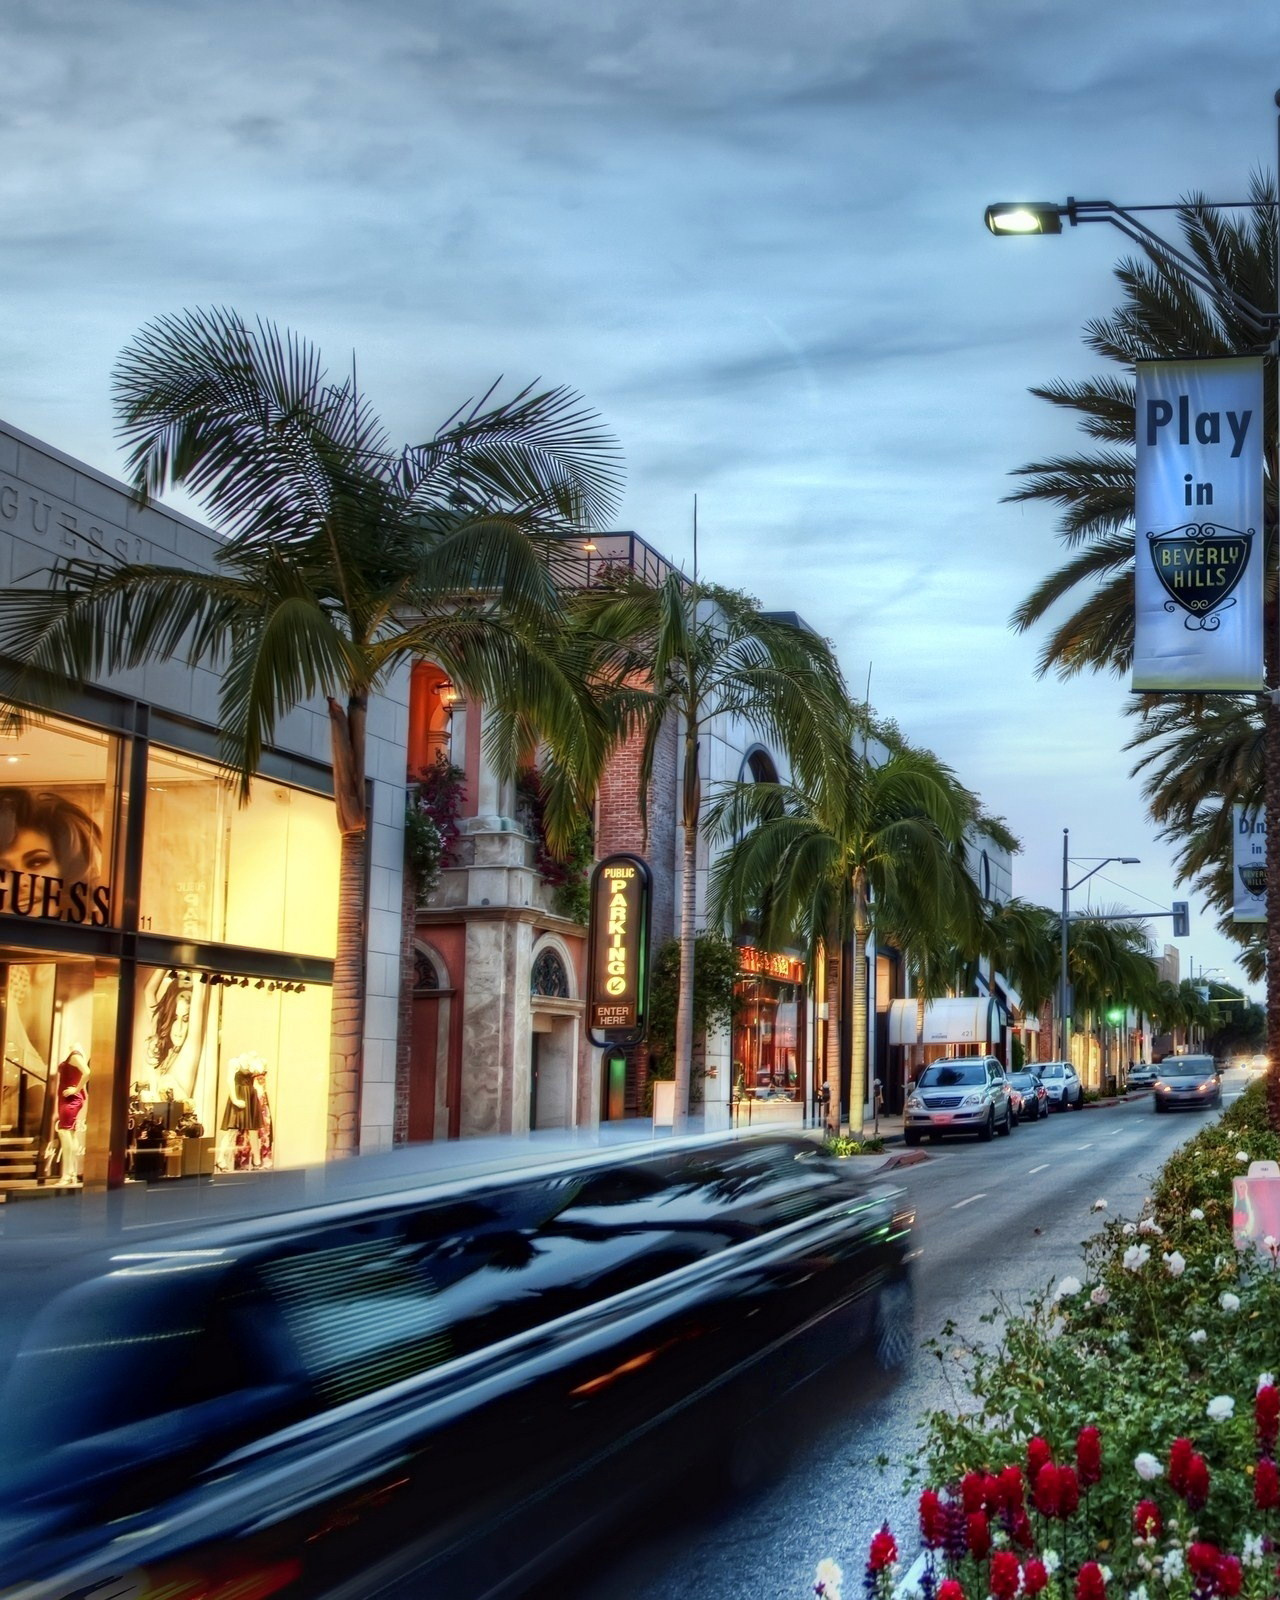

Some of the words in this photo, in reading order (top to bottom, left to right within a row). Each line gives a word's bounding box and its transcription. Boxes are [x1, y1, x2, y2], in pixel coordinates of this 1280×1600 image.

[1146, 395, 1253, 458] Play
[1184, 473, 1214, 506] in
[1162, 546, 1239, 567] BEVERLY
[1173, 568, 1226, 588] HILLS
[1251, 843, 1262, 854] in
[604, 867, 635, 879] PUBLIC
[607, 879, 628, 976] PARKING
[598, 1006, 629, 1016] ENTER
[600, 1016, 626, 1025] HERE
[961, 1030, 973, 1038] 421
